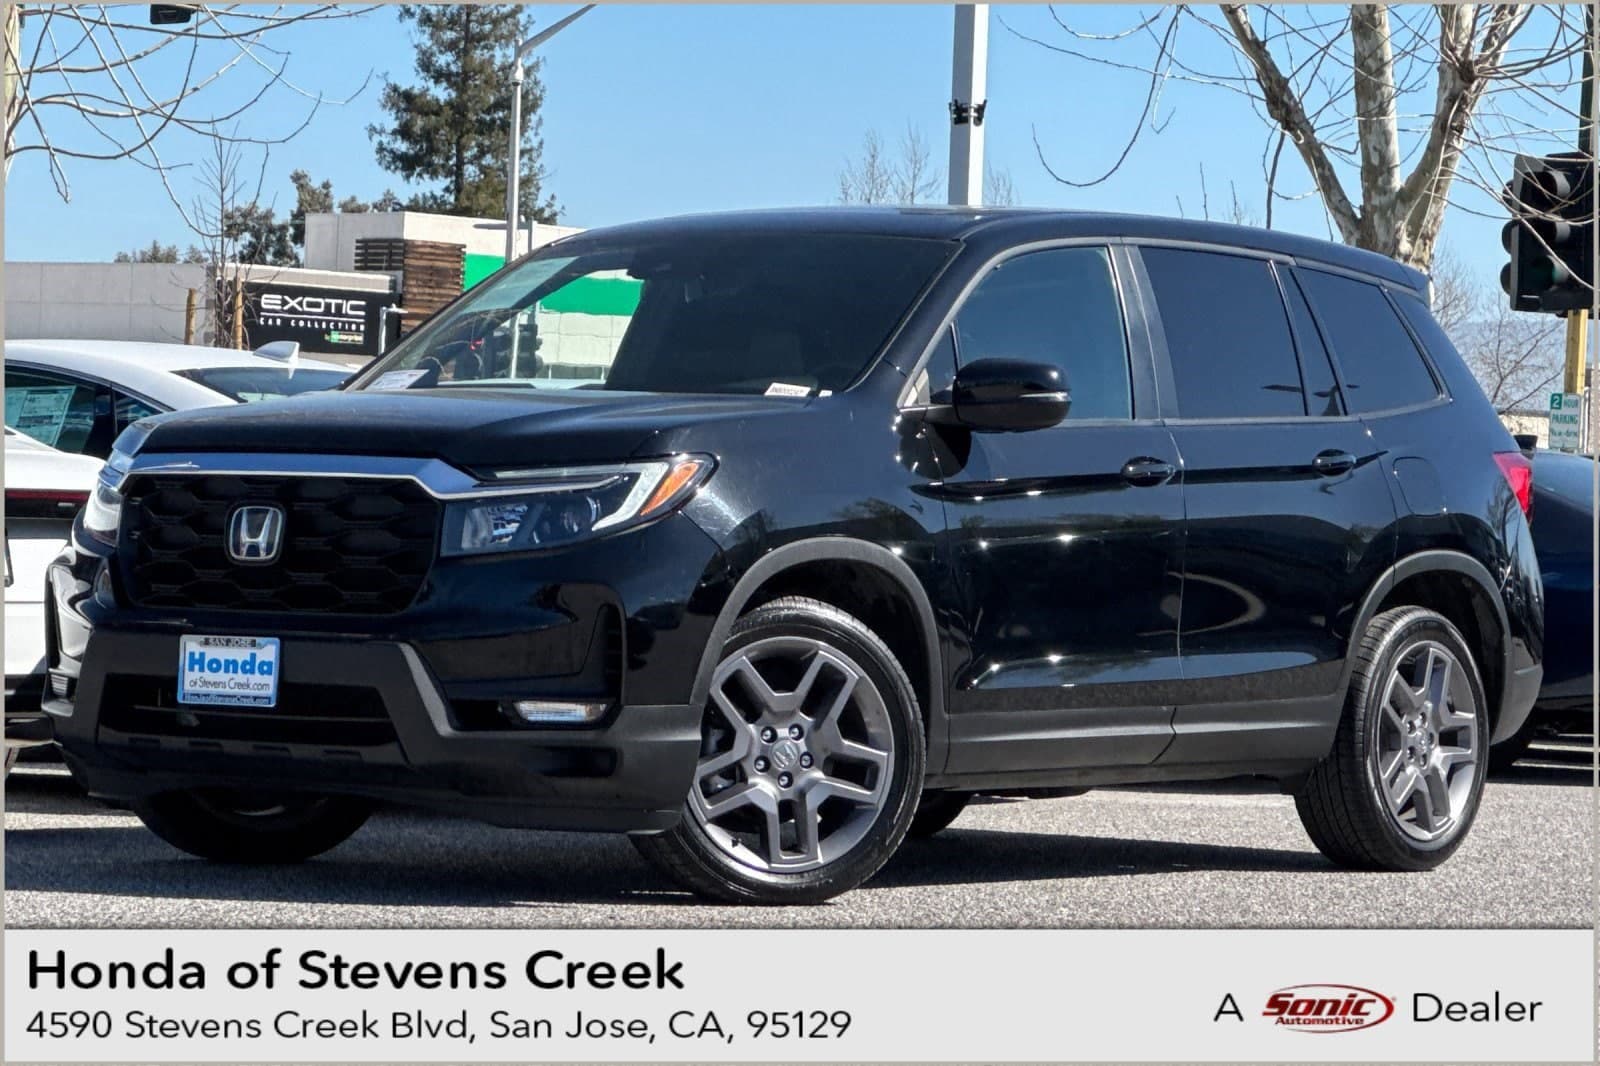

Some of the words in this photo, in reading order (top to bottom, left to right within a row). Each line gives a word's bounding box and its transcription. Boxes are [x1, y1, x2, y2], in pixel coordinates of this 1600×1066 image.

[260, 293, 366, 316] EXOTIC
[259, 317, 282, 326] CAR
[290, 319, 365, 331] COLLECTION
[1552, 395, 1560, 408] 2
[1551, 413, 1578, 424] PARKING
[210, 637, 227, 646] SAN
[230, 638, 252, 647] JOSE
[187, 651, 273, 676] Honda
[189, 678, 198, 688] of
[199, 676, 227, 690] Stevens
